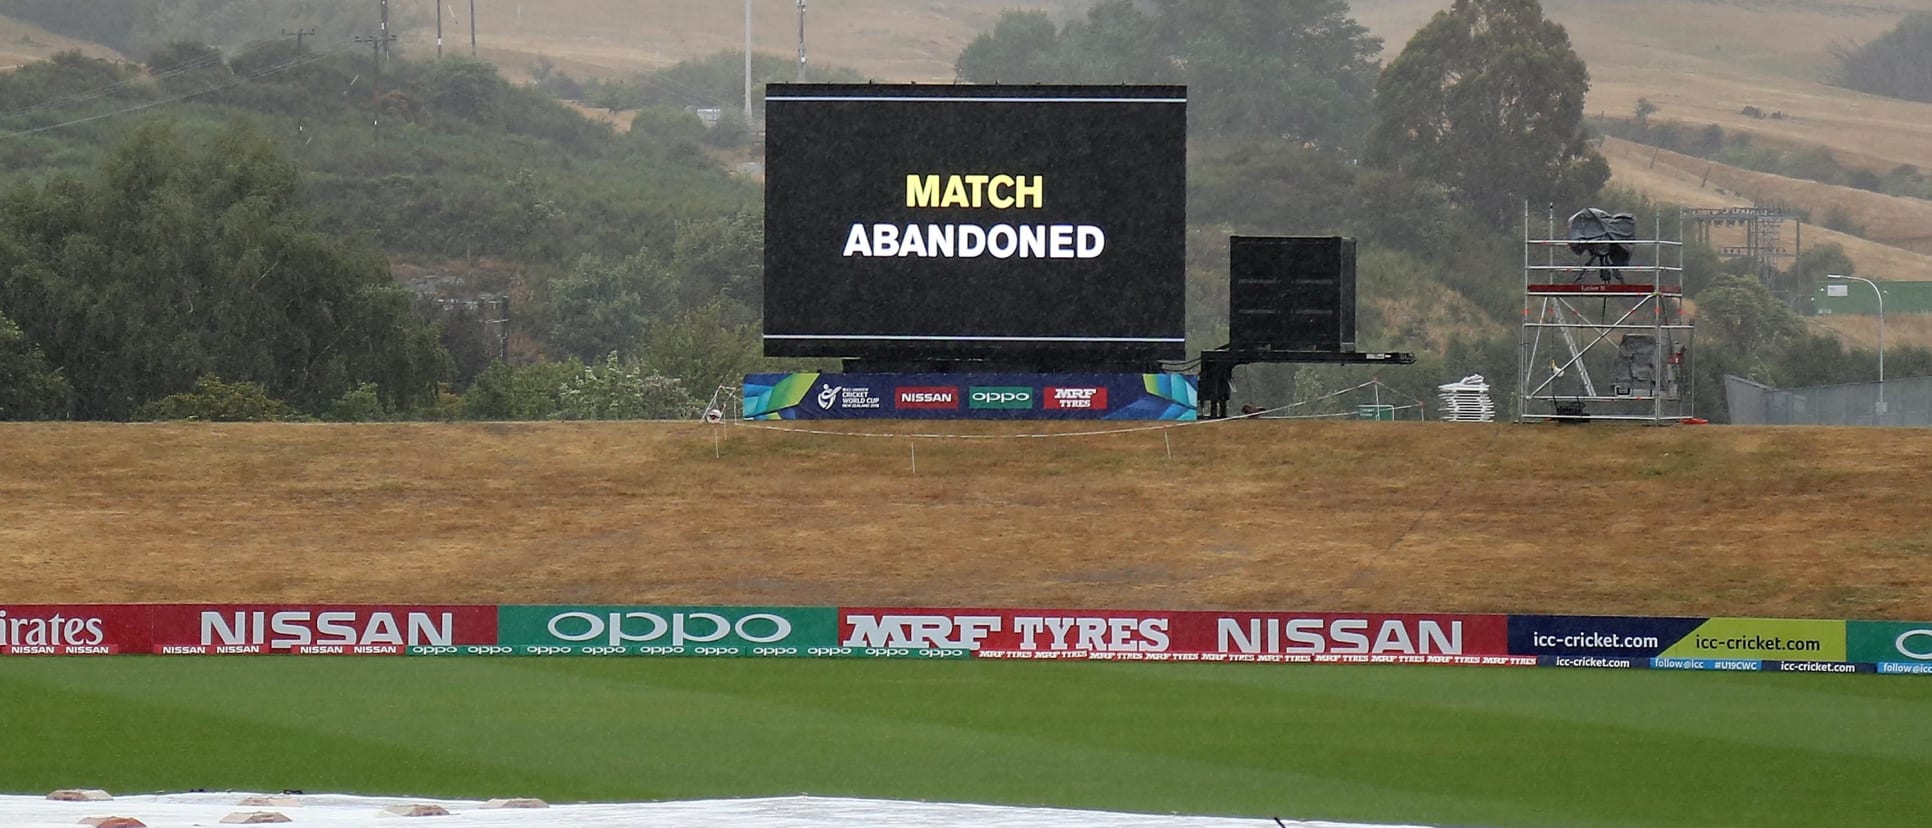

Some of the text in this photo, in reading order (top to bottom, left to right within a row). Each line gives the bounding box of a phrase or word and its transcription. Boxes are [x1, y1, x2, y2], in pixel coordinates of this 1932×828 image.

[906, 174, 1043, 209] MATCH
[843, 223, 1105, 258] ABANDONED
[901, 393, 952, 402] NISSAN
[1054, 388, 1096, 399] MRF
[1059, 400, 1091, 408] TYRES
[200, 611, 453, 648] NISSAN
[843, 615, 1170, 652] MRF TYRES
[1217, 618, 1463, 655] NISSAN
[1533, 632, 1659, 648] icc-cricket.com
[1695, 634, 1821, 651] icc-cricket.com
[11, 646, 55, 654] NISSAN
[65, 646, 109, 654] NISSAN
[163, 646, 206, 654] NISSAN
[216, 645, 260, 654] NISSAN
[300, 646, 343, 654] NISSAN
[353, 646, 397, 654] NISSAN
[1398, 655, 1425, 663] TYRES
[1454, 656, 1480, 664] TYRES
[1510, 657, 1537, 665] TYRES
[1556, 656, 1630, 668] icc-cricket.com
[1715, 661, 1757, 670] #U19CWC
[1780, 661, 1855, 673] icc-cricket.com
